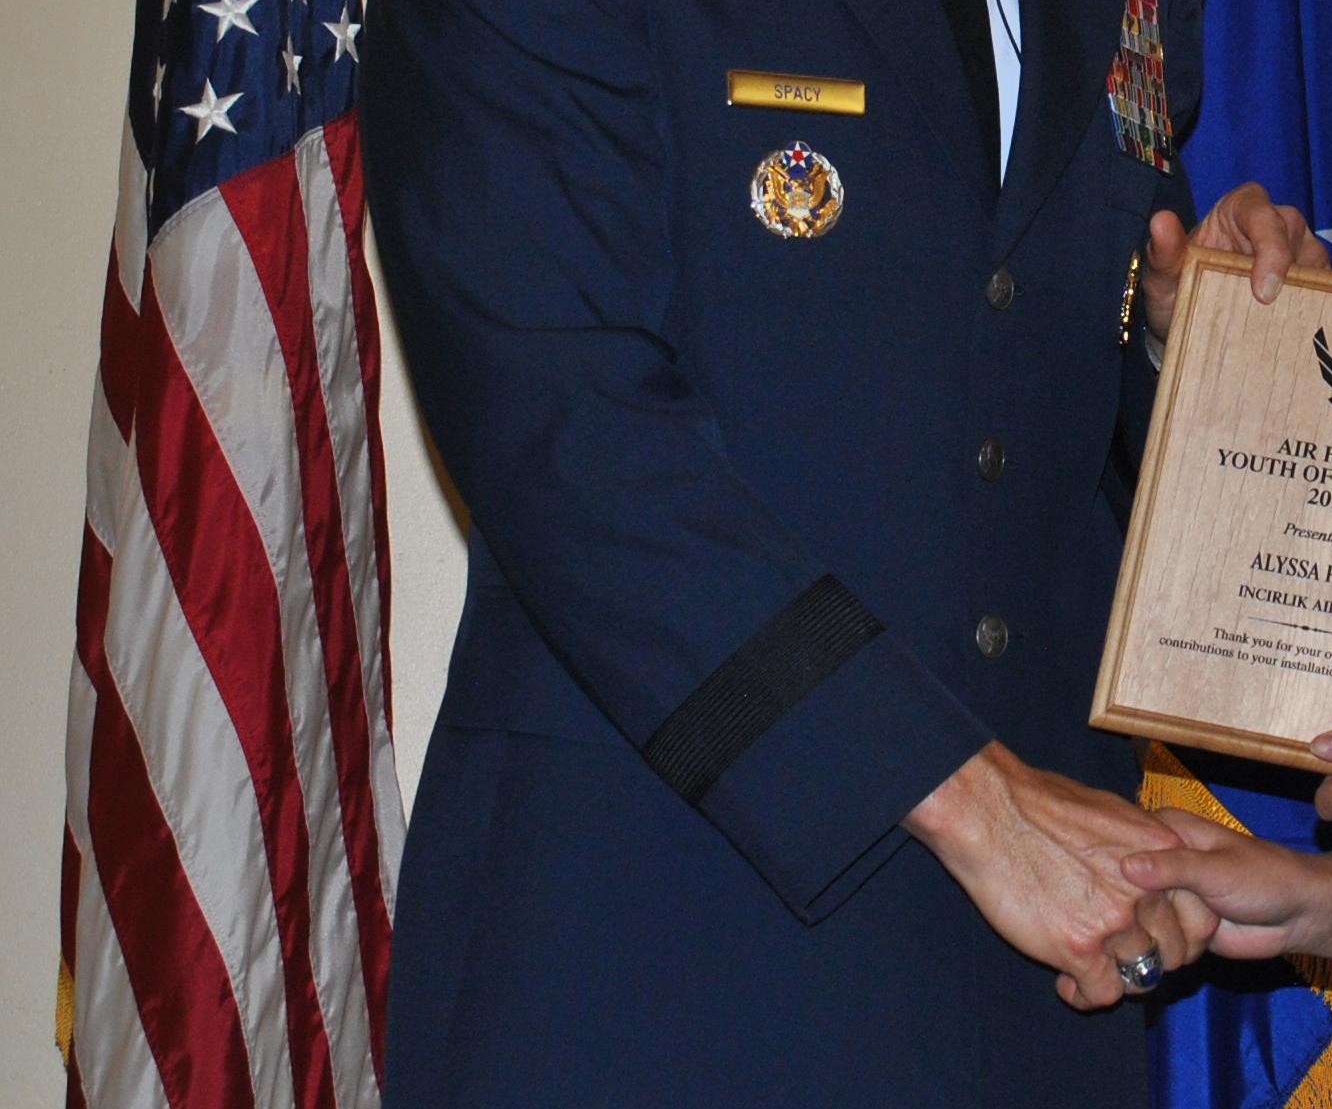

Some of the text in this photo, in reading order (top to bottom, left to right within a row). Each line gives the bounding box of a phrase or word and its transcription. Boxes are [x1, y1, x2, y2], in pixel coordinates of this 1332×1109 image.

[774, 83, 822, 103] SPACY
[1218, 449, 1297, 479] YOUTH
[1277, 438, 1317, 460] AIR
[1250, 551, 1319, 581] ALYSSA
[1238, 584, 1308, 609] INCIRLIK
[1159, 636, 1234, 658] contributions
[1237, 650, 1249, 660] to
[1251, 654, 1278, 667] your
[1213, 628, 1249, 644] Thank
[1251, 636, 1273, 649] you
[1275, 639, 1292, 652] for
[1293, 644, 1322, 658] your
